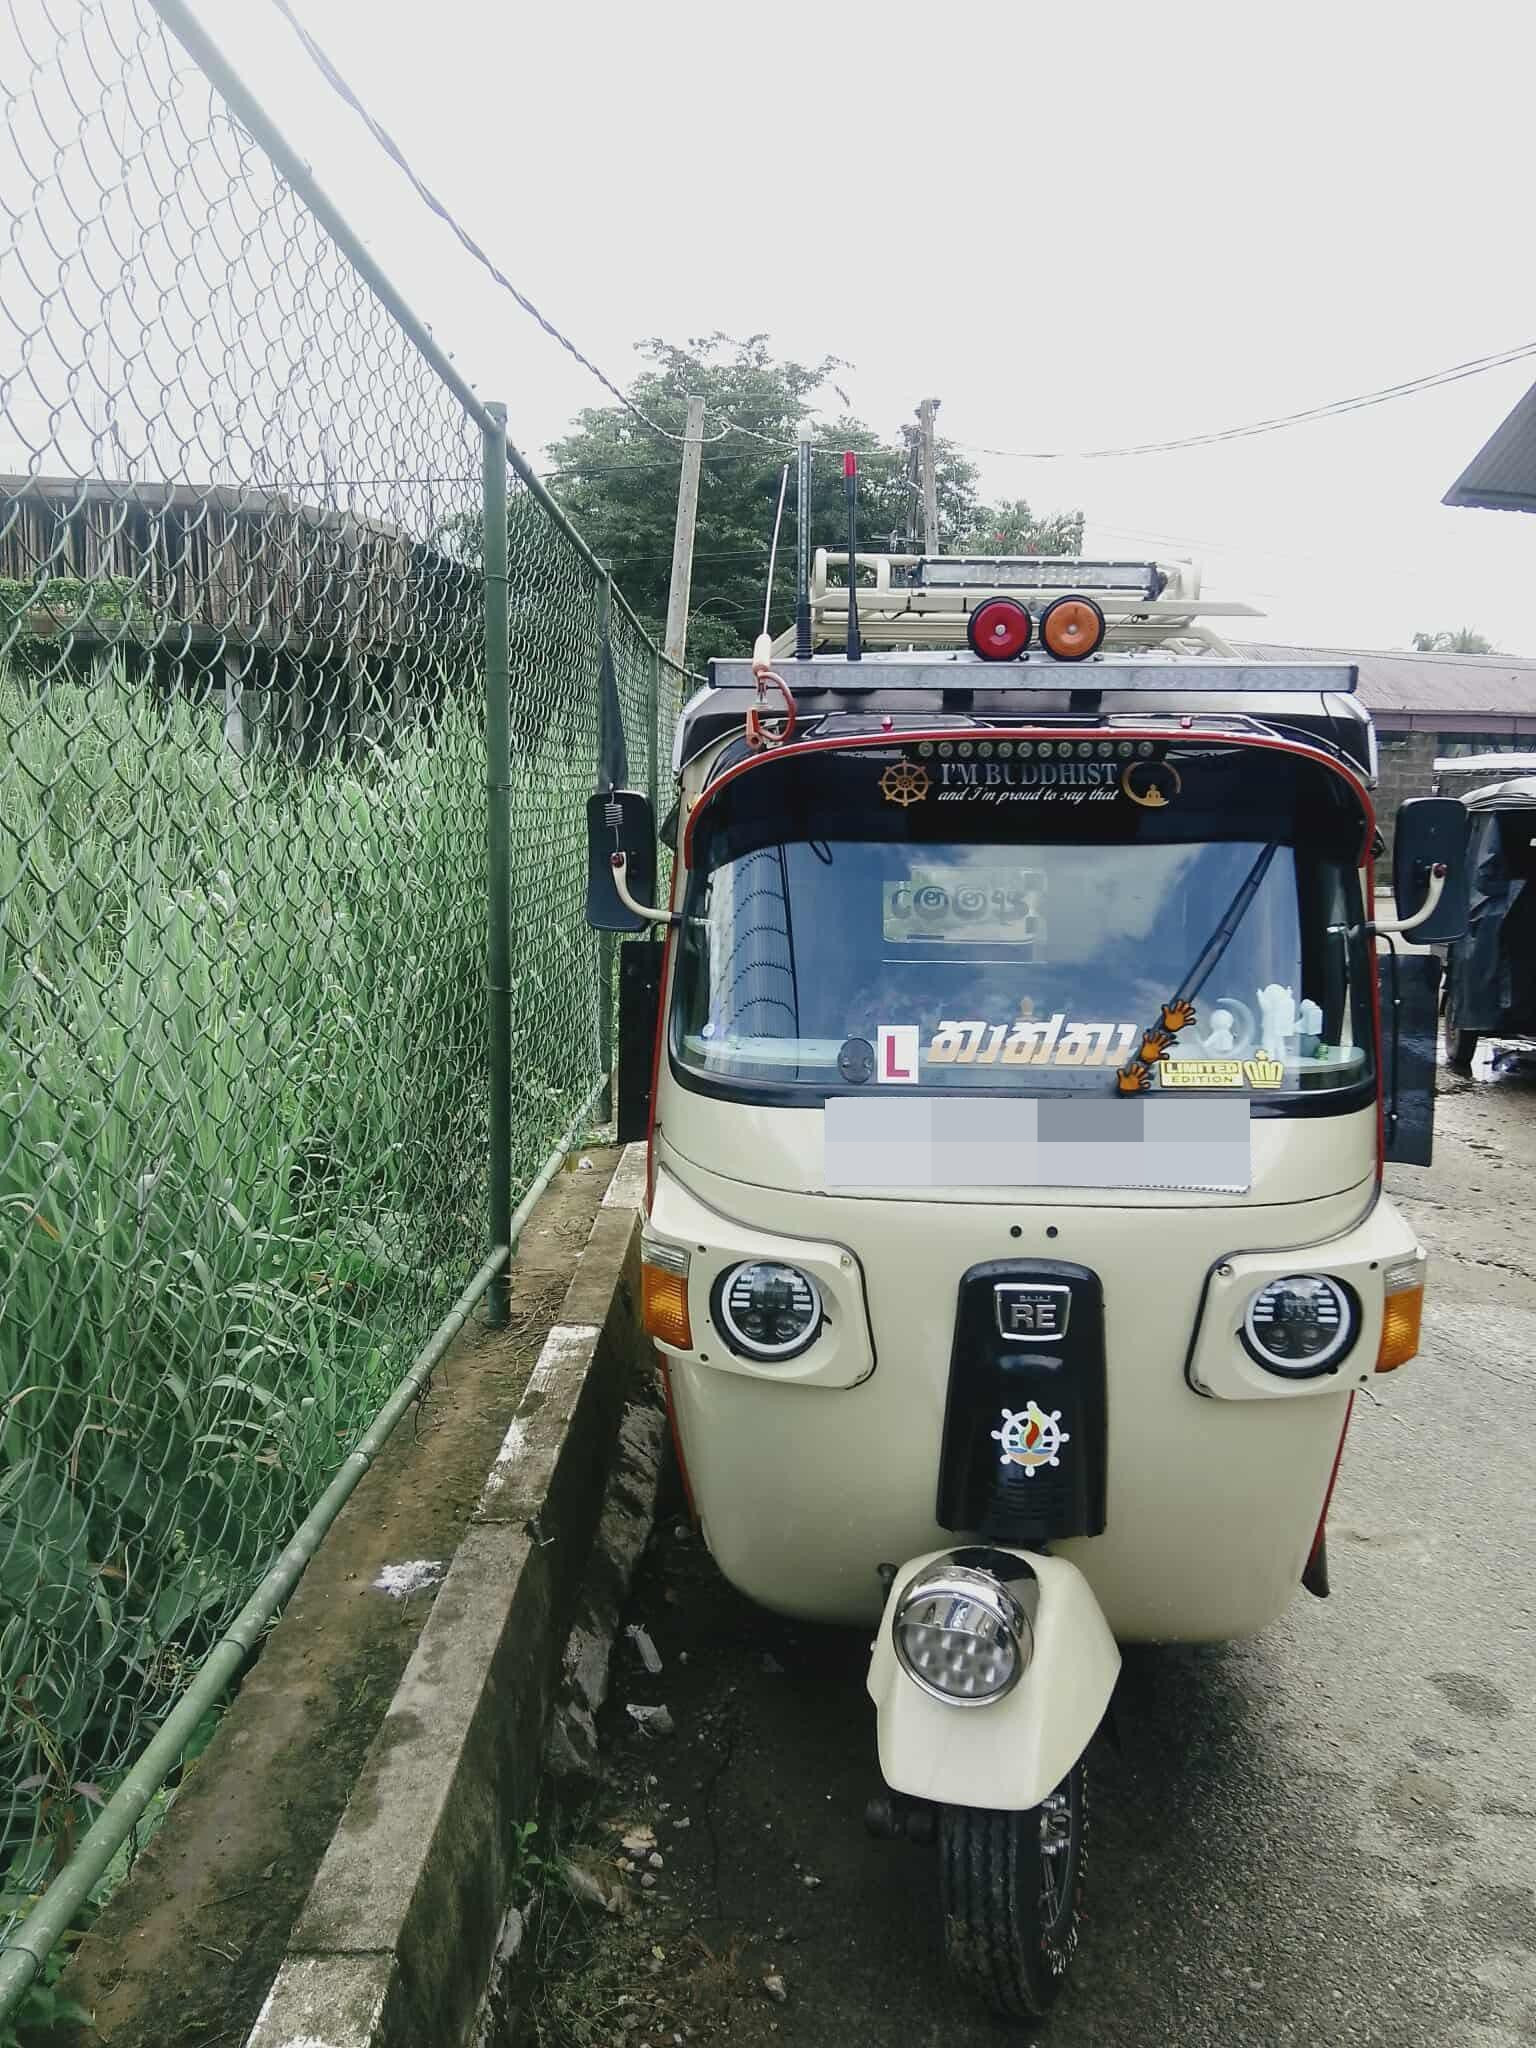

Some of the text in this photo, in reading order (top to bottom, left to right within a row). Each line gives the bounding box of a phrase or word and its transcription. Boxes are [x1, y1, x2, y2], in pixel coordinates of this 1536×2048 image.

[940, 762, 1118, 785] I'M BUDDHIST
[937, 785, 1120, 806] and I'm proud to say that
[885, 1034, 910, 1078] L
[1165, 1061, 1239, 1074] LIMITED
[1171, 1075, 1233, 1083] EDITION
[1010, 1303, 1057, 1328] RE
